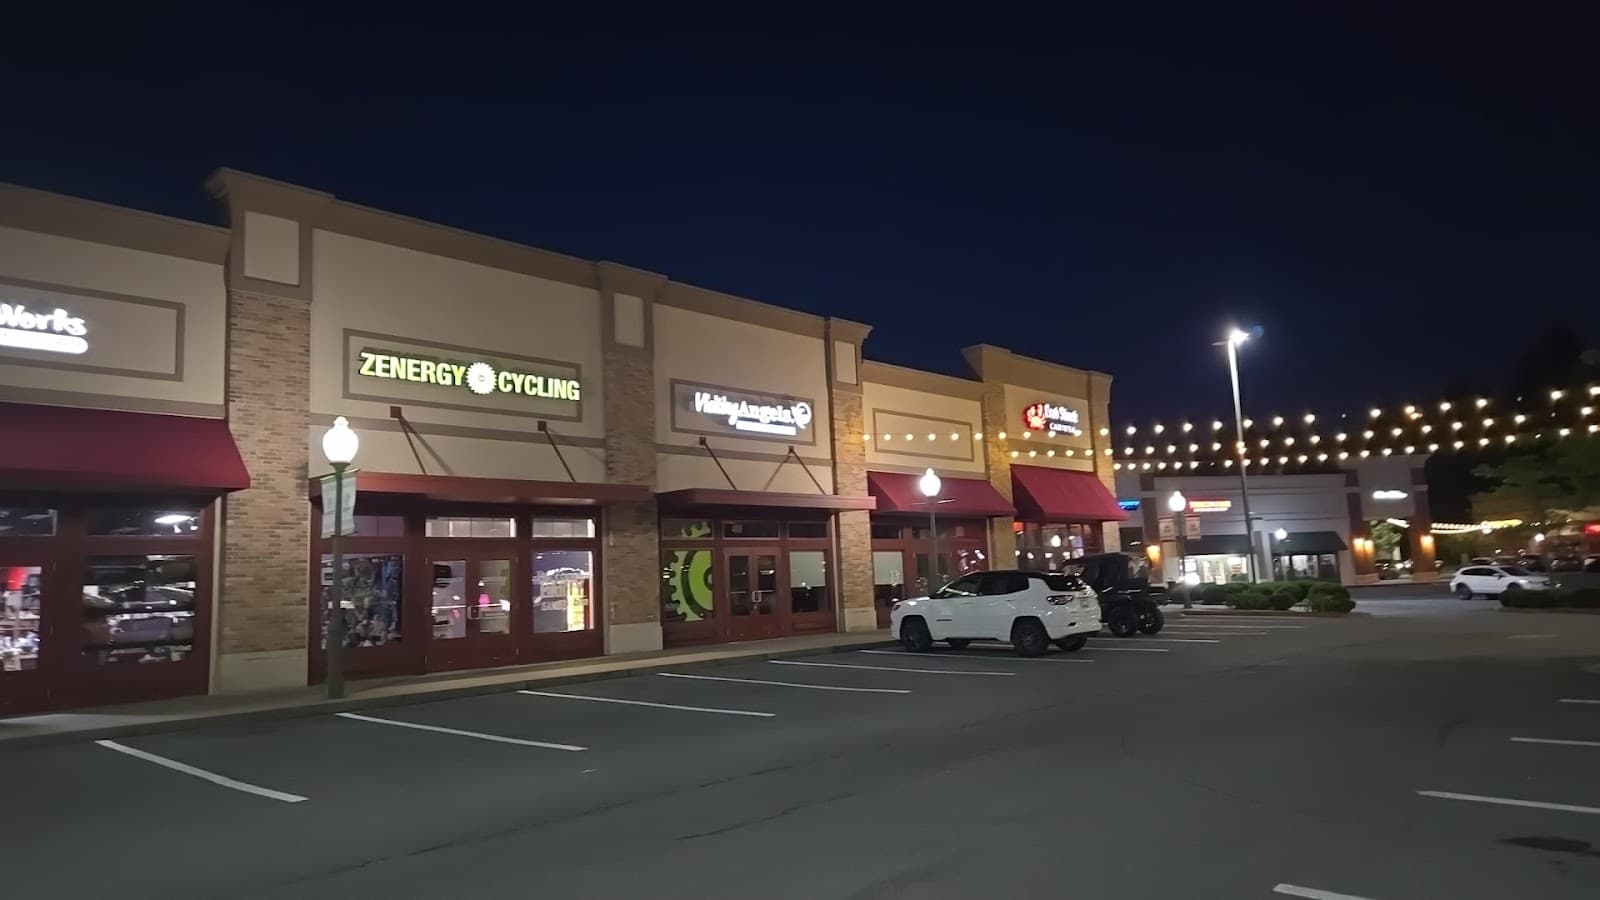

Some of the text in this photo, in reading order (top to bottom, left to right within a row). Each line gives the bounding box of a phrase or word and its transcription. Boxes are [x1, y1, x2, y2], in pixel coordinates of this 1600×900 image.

[360, 351, 581, 401] ZENERGY CYCLING
[739, 400, 793, 425] Angels
